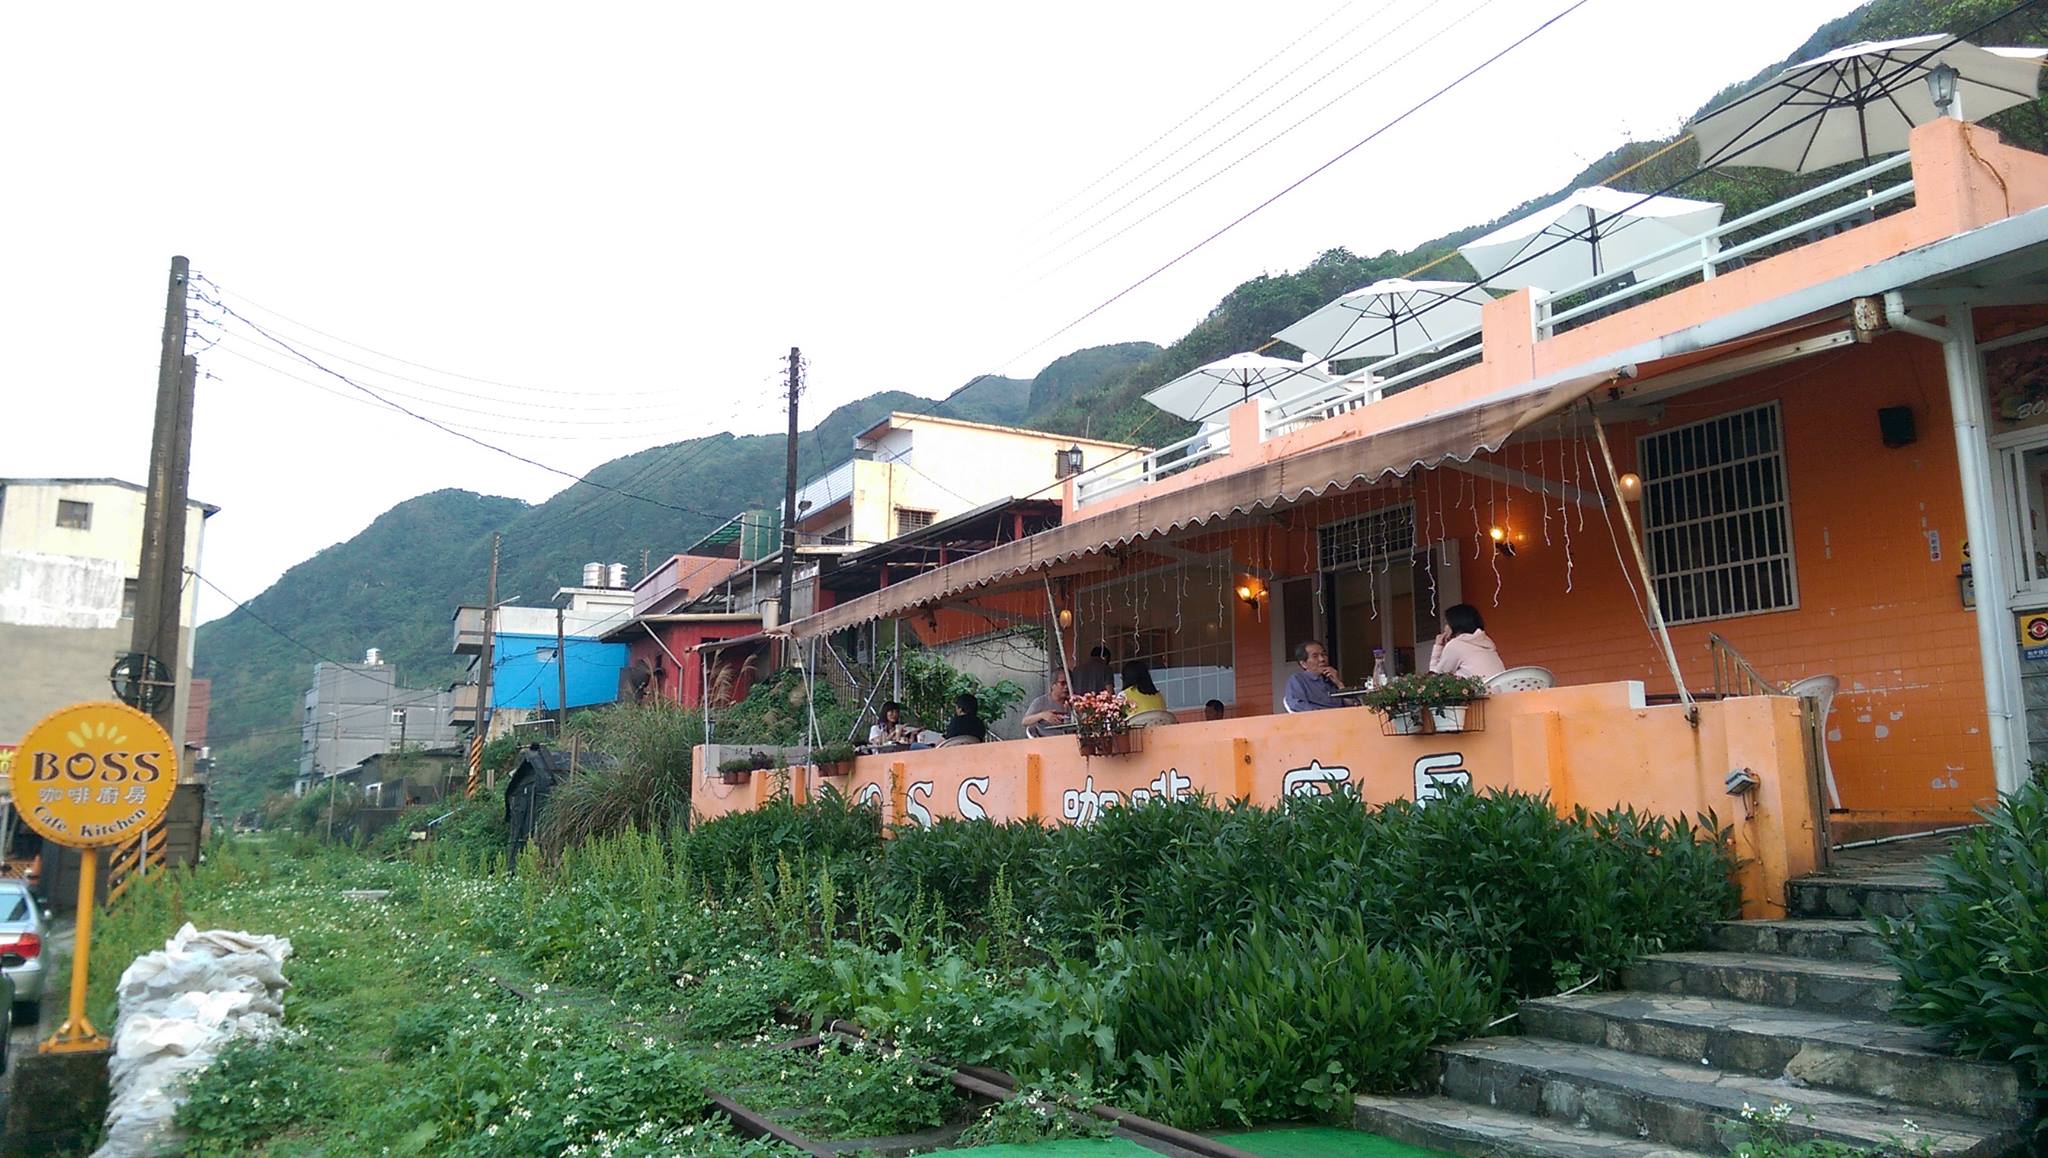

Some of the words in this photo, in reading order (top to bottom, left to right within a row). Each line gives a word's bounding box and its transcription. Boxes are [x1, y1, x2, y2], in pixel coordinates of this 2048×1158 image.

[2017, 400, 2048, 419] BO
[32, 752, 160, 783] BOSS
[80, 808, 146, 838] Kitchen
